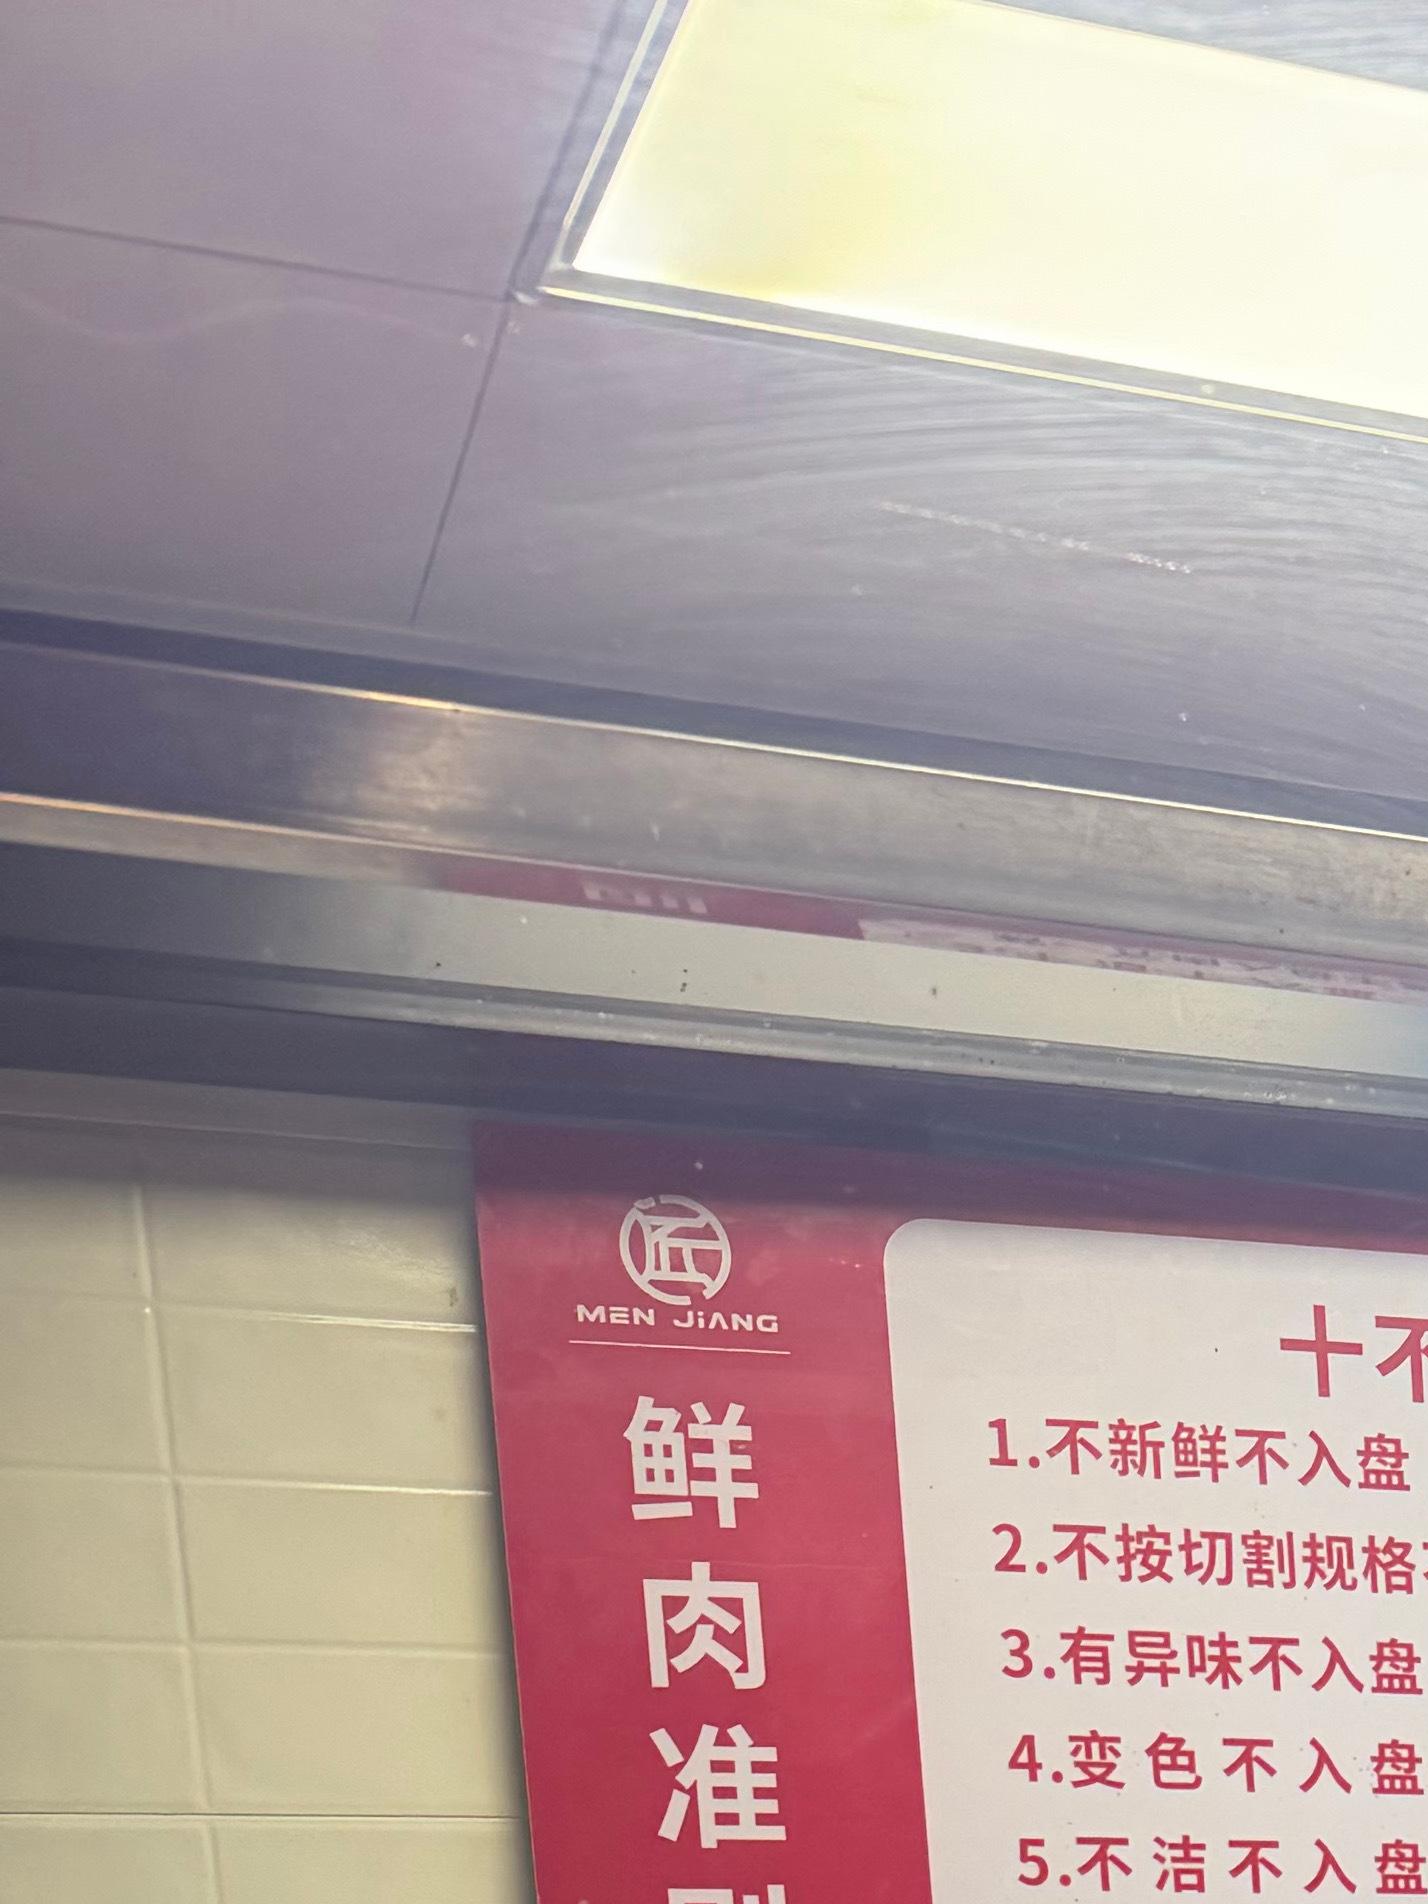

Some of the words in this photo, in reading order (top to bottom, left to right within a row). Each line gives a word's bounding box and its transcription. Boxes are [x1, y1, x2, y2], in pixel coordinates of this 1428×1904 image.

[576, 1303, 655, 1329] MEN
[986, 1417, 1412, 1494] 1.不新鲜不入盘
[1001, 1626, 1424, 1698] 3.有异味不入盘
[1007, 1732, 1426, 1798] 4.变色不入盘
[1016, 1835, 1428, 1898] 5.不洁不入盘
